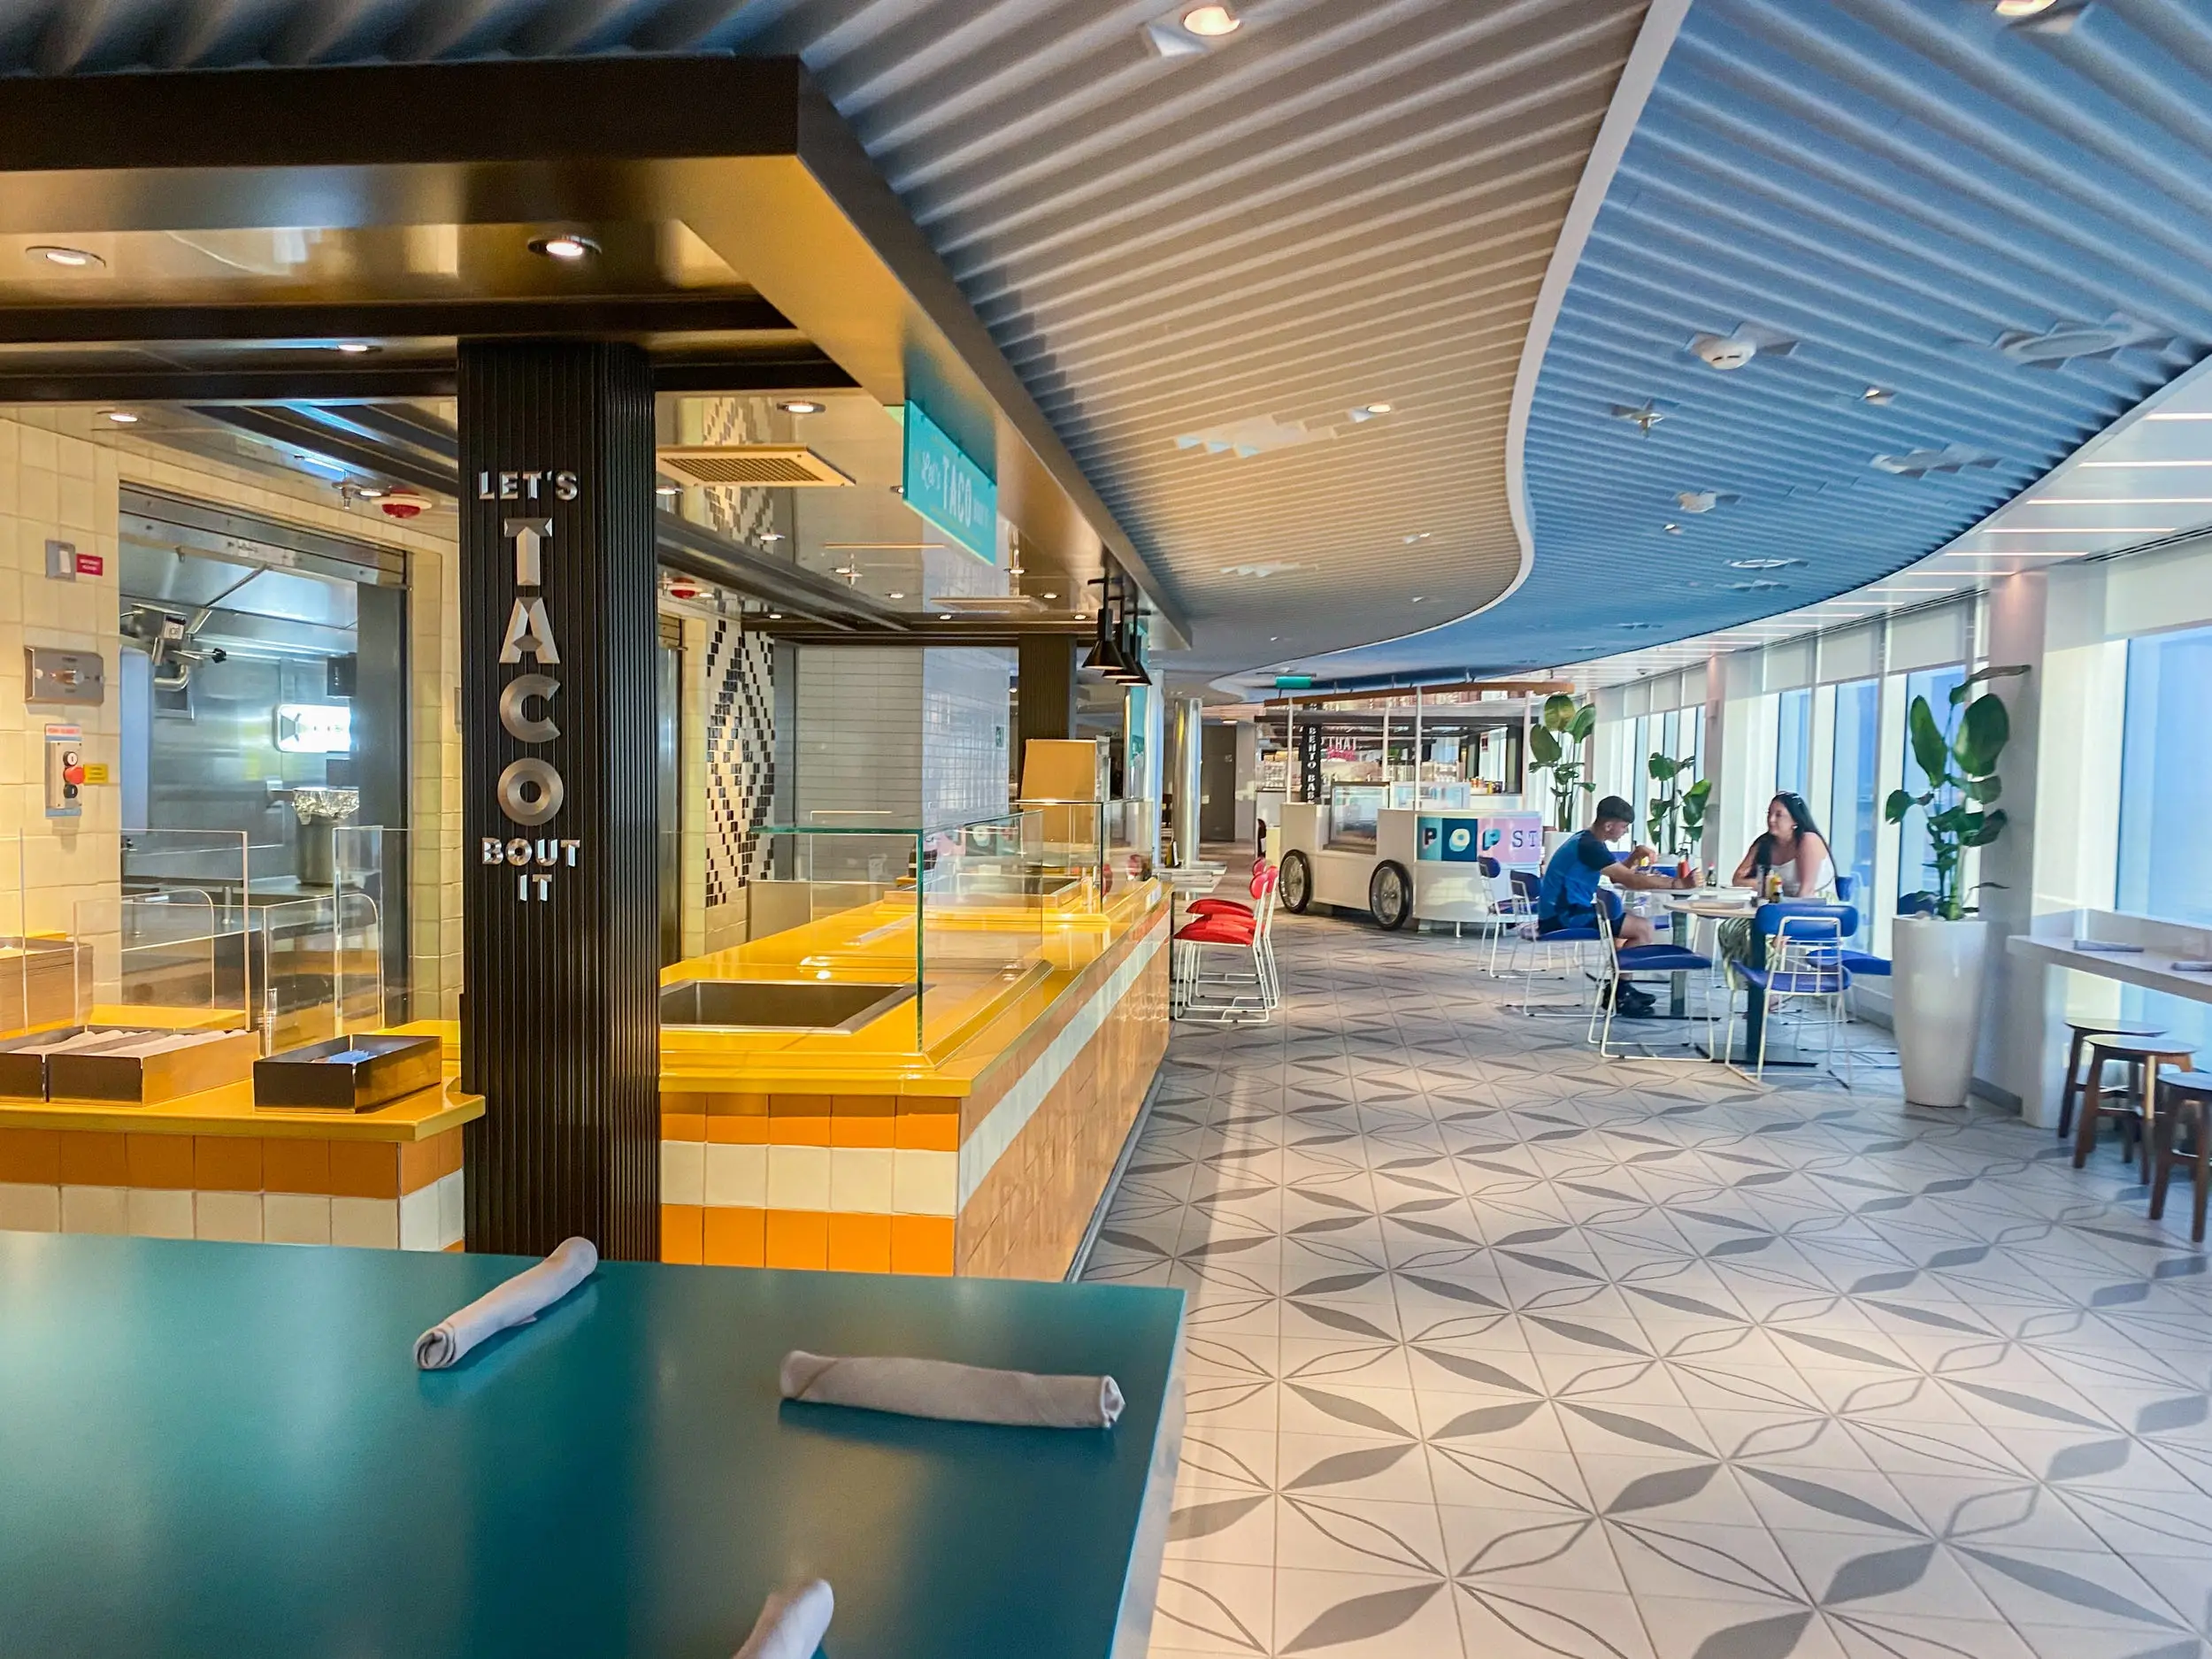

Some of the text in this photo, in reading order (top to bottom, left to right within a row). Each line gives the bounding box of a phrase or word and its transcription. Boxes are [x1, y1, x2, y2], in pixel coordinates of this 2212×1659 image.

[479, 470, 579, 501] LET'S
[943, 455, 972, 528] TACO
[497, 518, 565, 826] TACO
[1327, 736, 1356, 751] THAT
[1307, 727, 1317, 803] BENTO BAB
[481, 837, 580, 867] BOUT
[1423, 827, 1502, 851] POP
[518, 874, 552, 902] IT
